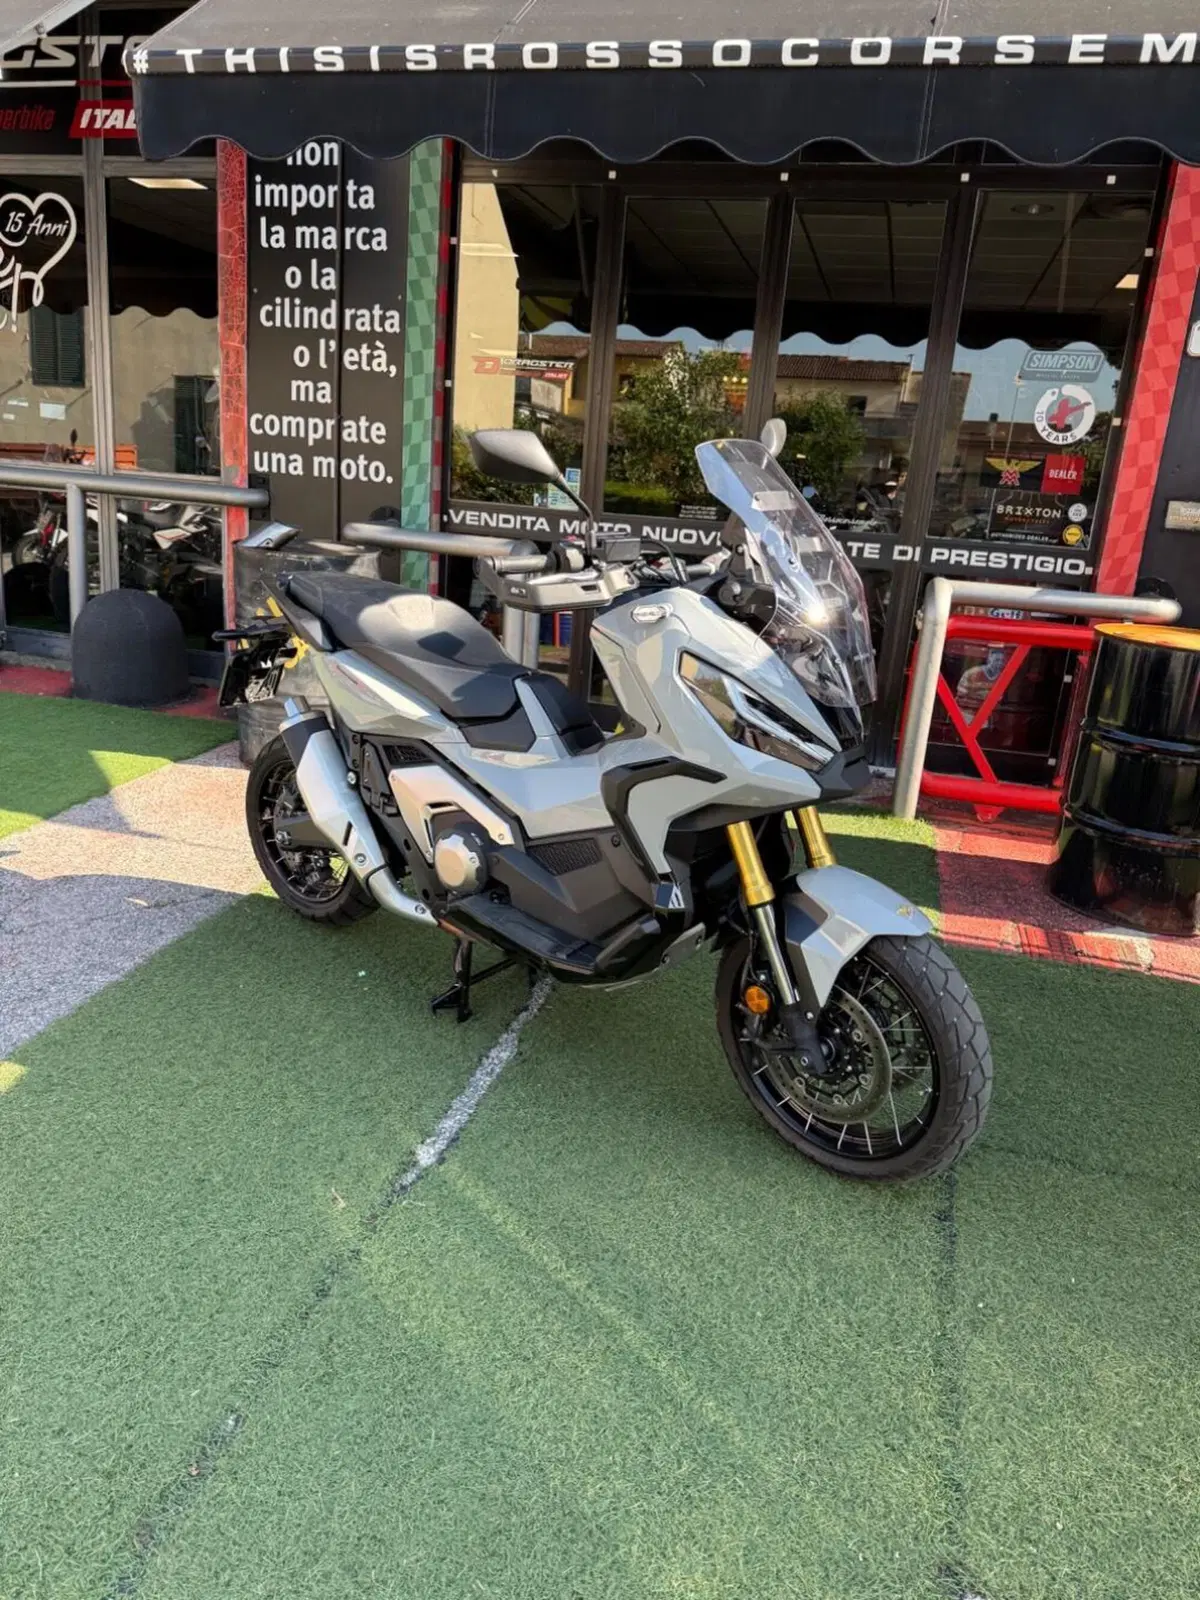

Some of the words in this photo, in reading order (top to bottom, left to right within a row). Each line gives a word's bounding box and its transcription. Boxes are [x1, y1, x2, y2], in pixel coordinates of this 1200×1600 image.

[0, 104, 56, 131] erbike
[5, 211, 25, 233] 15
[26, 213, 70, 237] Anni
[260, 216, 286, 249] la
[285, 265, 302, 289] o
[311, 258, 336, 290] la
[293, 345, 310, 368] o
[1030, 353, 1098, 370] SIMPSON
[291, 379, 331, 404] ma
[1040, 426, 1077, 442] YEARS
[254, 451, 303, 476] una
[1048, 469, 1077, 481] DEALER
[996, 504, 1062, 519] BRIXTON
[642, 526, 722, 546] NUOV
[892, 544, 921, 562] DI
